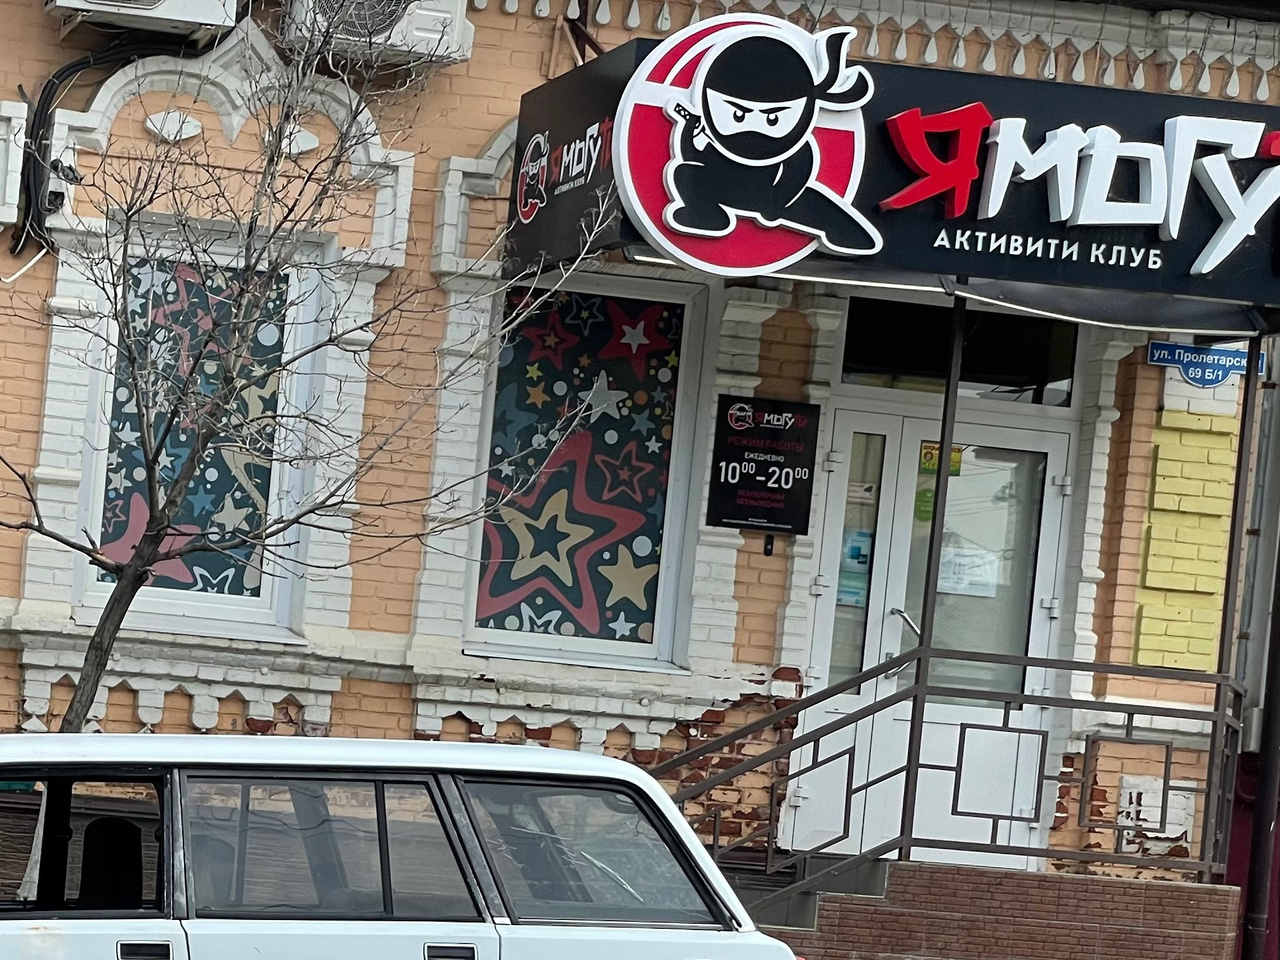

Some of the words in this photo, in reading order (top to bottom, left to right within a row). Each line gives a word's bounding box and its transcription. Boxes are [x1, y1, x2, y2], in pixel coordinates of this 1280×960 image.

[878, 101, 1280, 276] ЯМОГУ
[933, 228, 1079, 262] АКТИВИТИ
[1089, 243, 1163, 271] КЛУБ
[1153, 349, 1171, 361] ул.
[1175, 349, 1248, 369] Пролетарск
[1188, 367, 1202, 379] 69
[1204, 368, 1223, 381] Б/1
